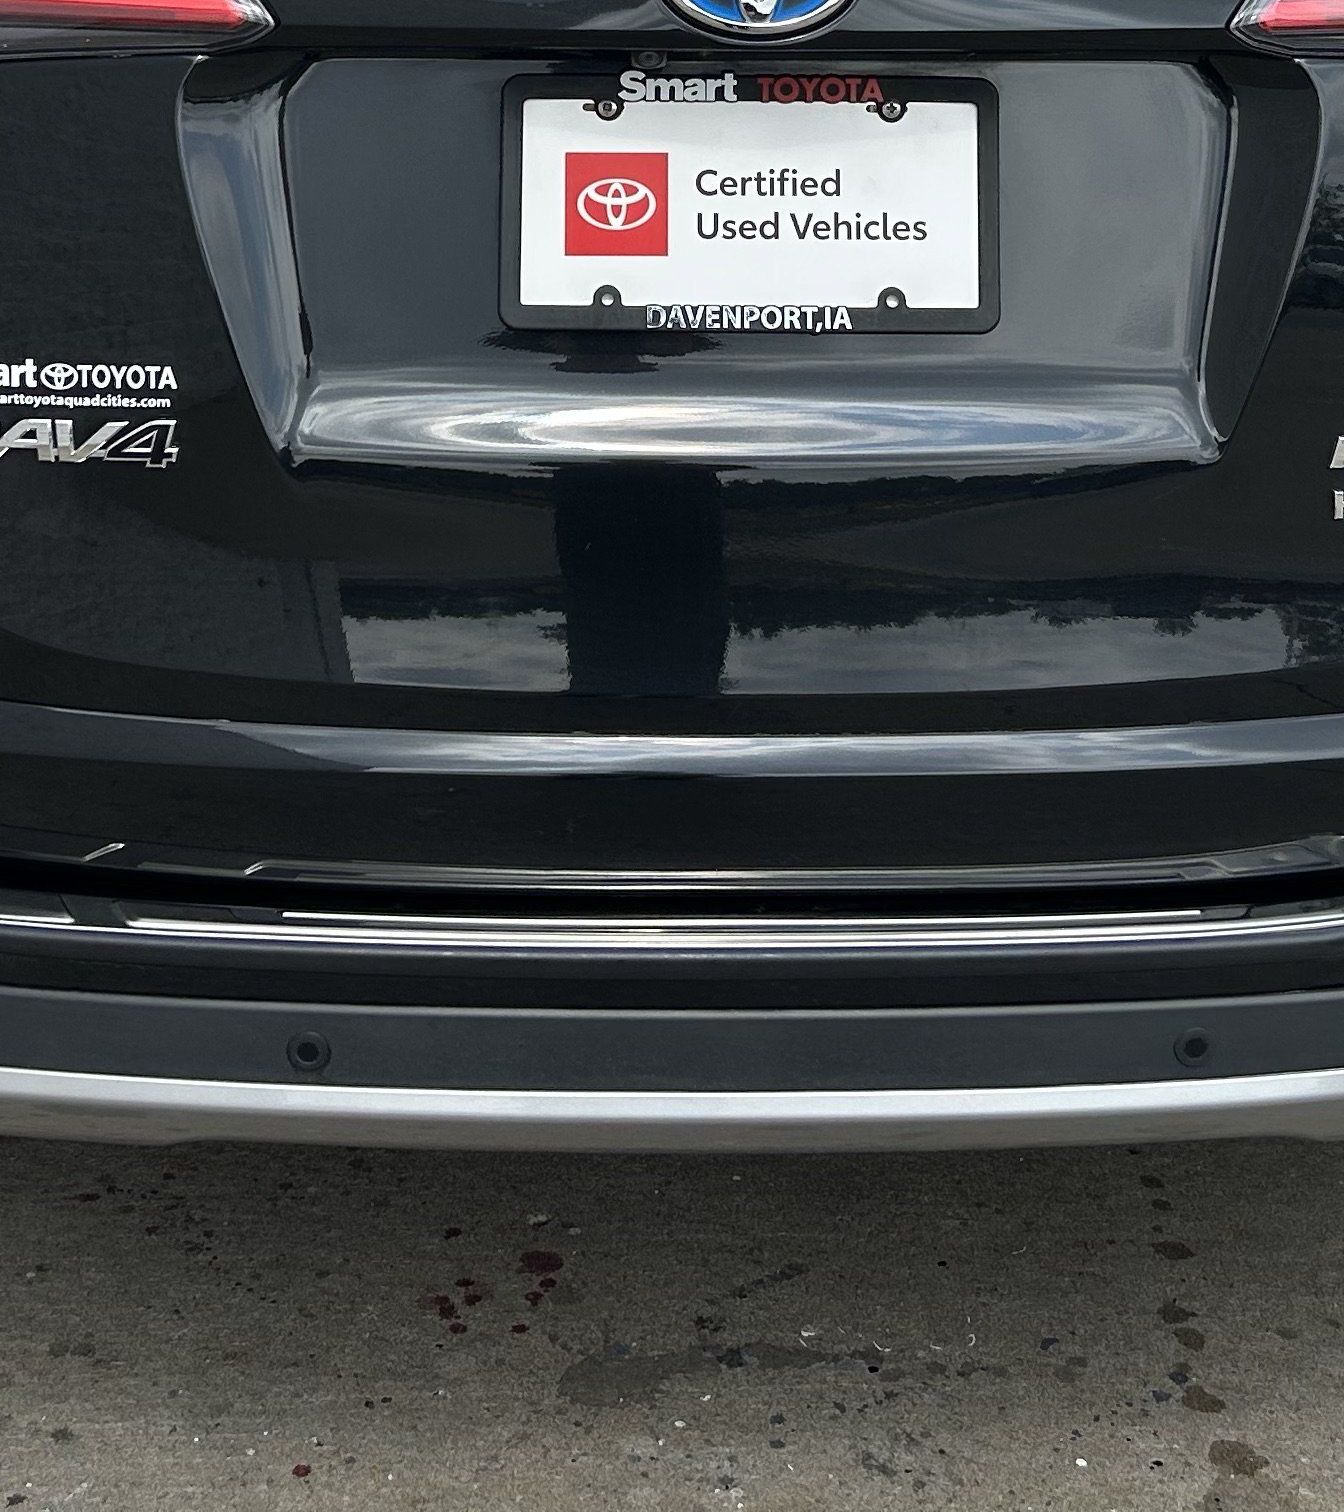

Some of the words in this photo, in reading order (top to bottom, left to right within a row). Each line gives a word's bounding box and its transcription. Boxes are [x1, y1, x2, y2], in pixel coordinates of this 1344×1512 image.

[618, 69, 738, 103] Smart
[757, 77, 884, 104] TOYOTA
[695, 168, 842, 197] Certified
[696, 212, 781, 241] Used
[791, 212, 928, 241] Vehicles
[77, 364, 178, 390] TOYOTA
